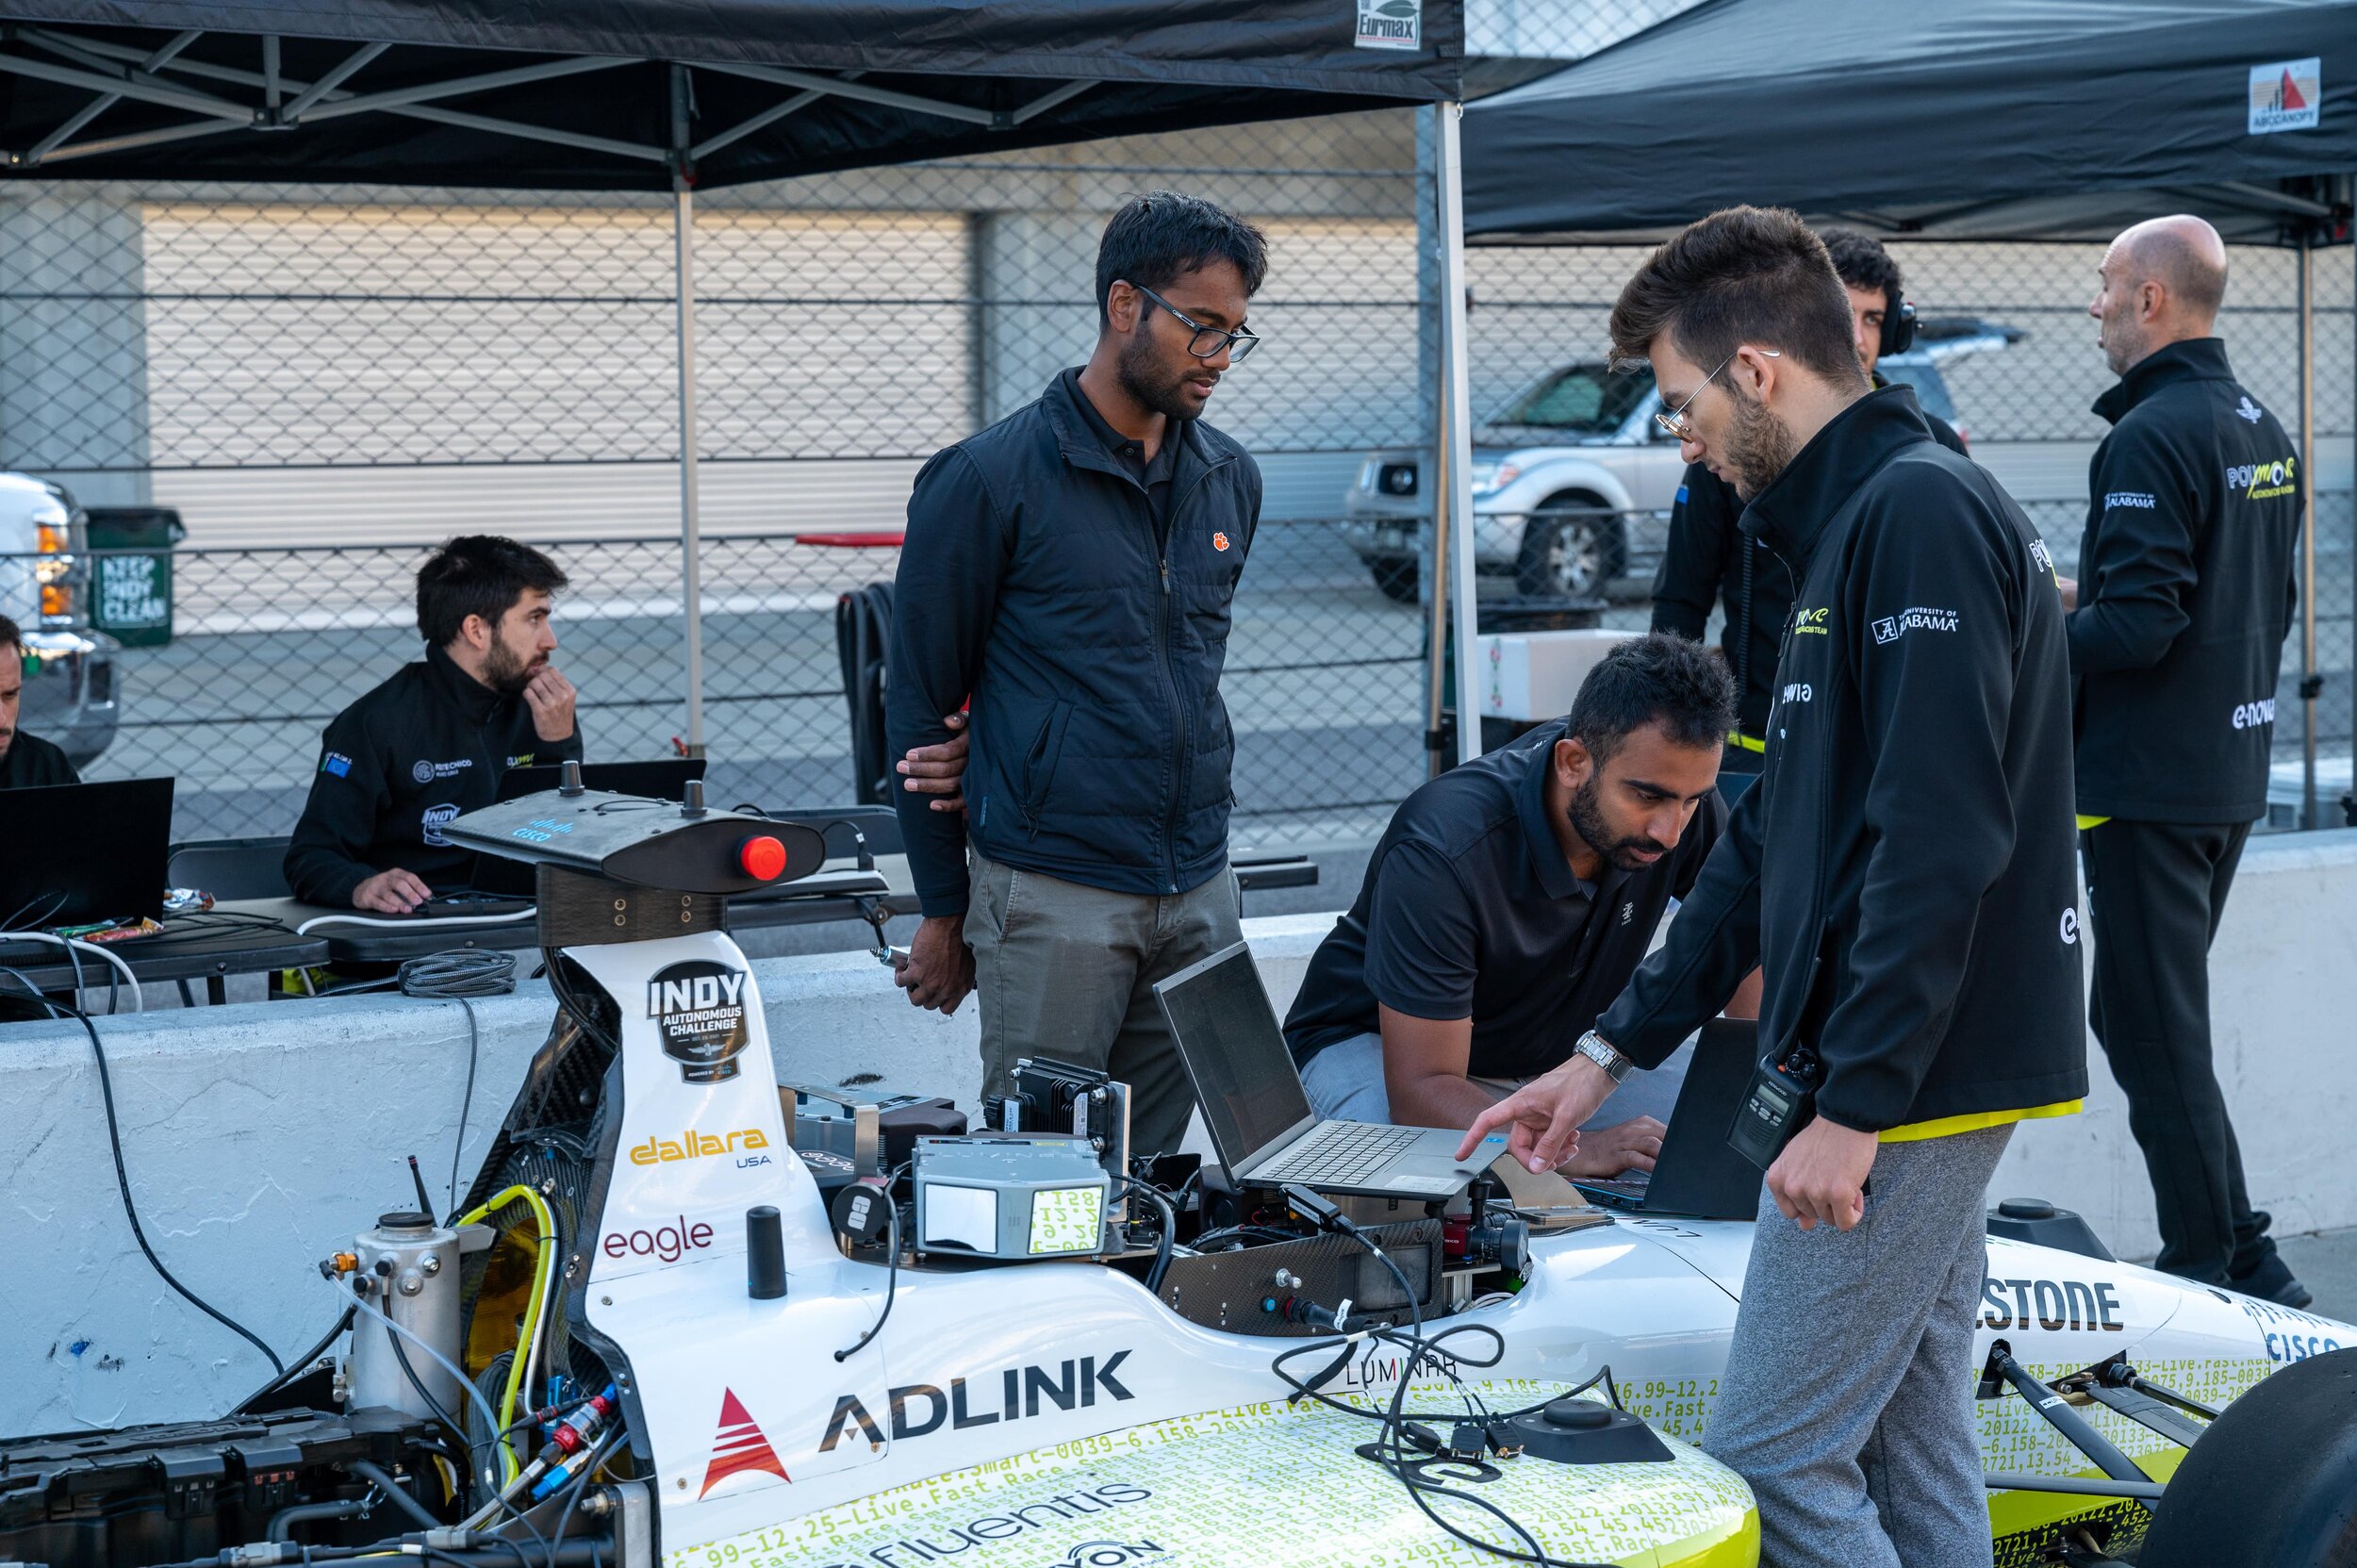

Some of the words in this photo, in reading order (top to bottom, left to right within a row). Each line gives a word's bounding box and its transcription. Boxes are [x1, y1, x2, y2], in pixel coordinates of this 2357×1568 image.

[1359, 13, 1414, 39] Eurmax
[650, 972, 744, 1015] INDY
[663, 1006, 742, 1027] AUTONOMOUS
[669, 1017, 737, 1036] CHALLENGE
[630, 1129, 769, 1166] dallara
[736, 1155, 771, 1169] USA
[603, 1214, 714, 1263] eagle
[1975, 1278, 2124, 1331] STONE
[818, 1349, 1136, 1453] ADLINK
